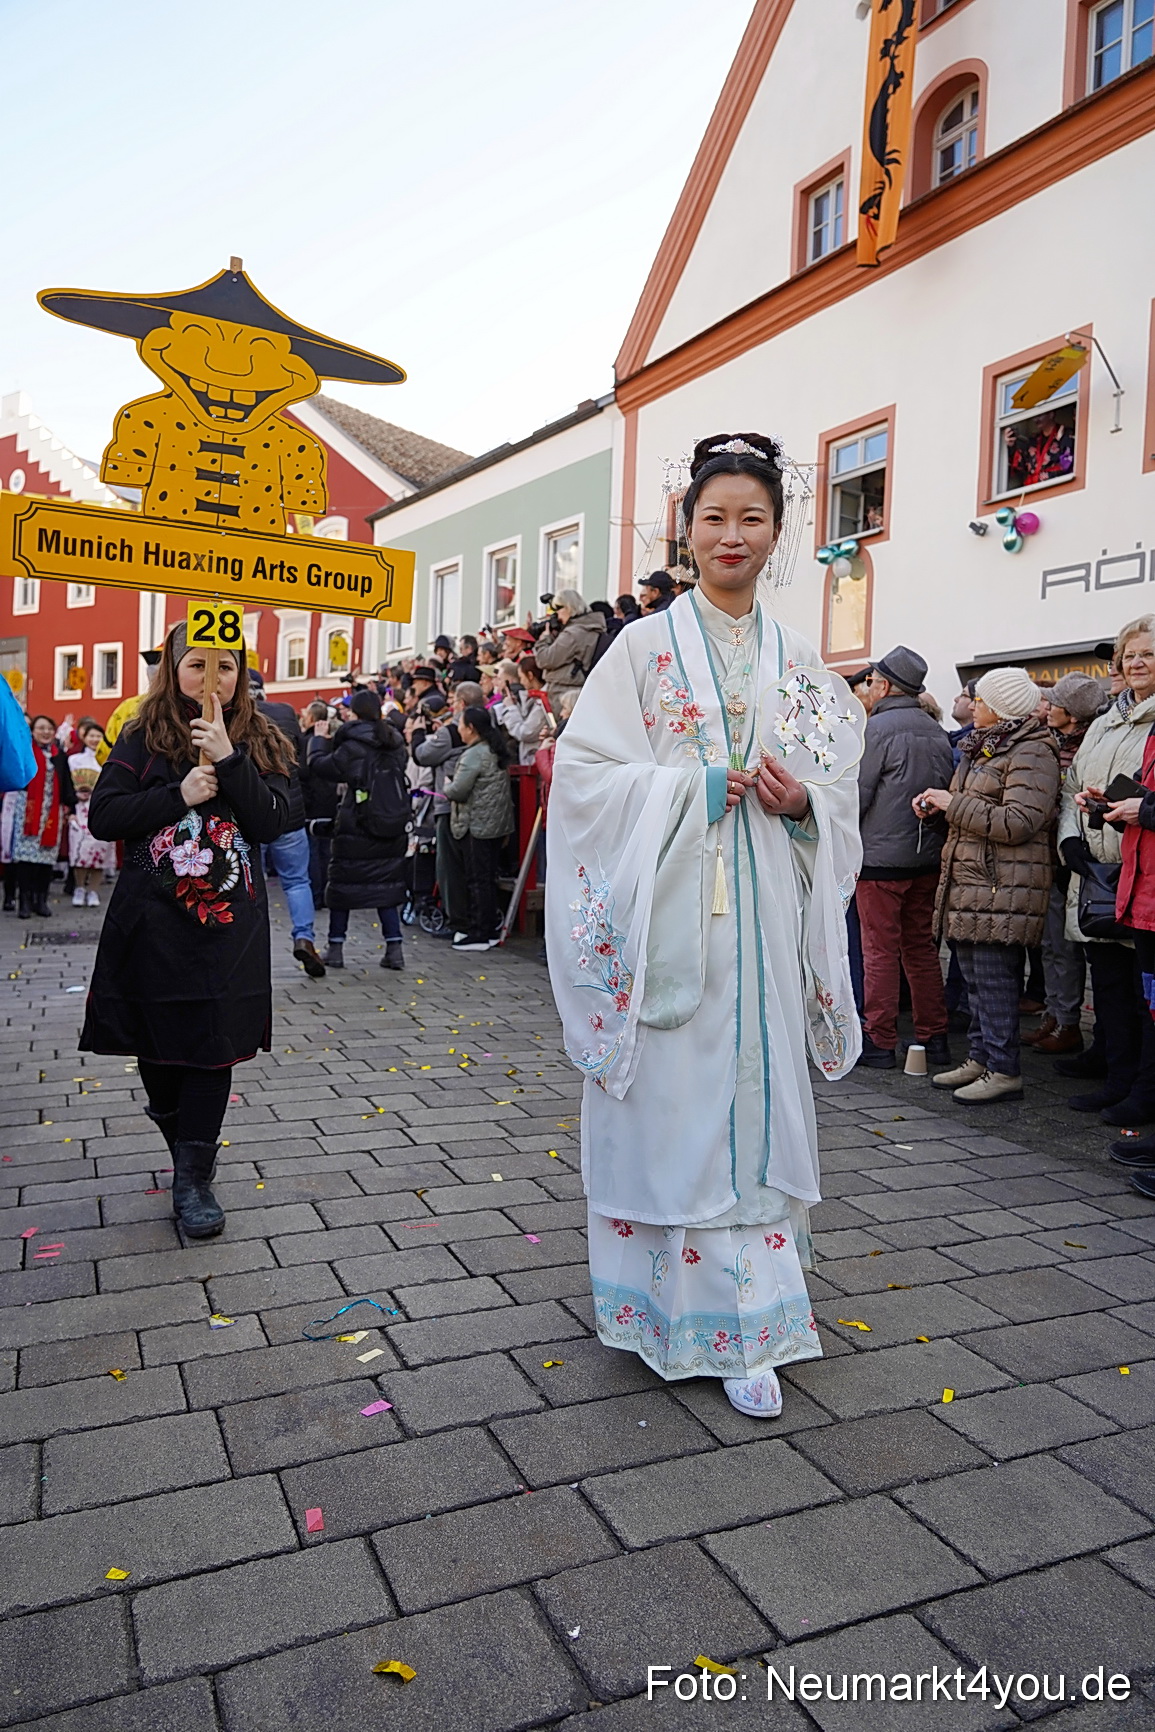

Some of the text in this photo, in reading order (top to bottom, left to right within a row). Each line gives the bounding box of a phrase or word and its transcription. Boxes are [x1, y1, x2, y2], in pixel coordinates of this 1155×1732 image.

[37, 528, 374, 598] Munich Huaxing Arts Group
[1041, 541, 1155, 600] RÖ
[192, 609, 241, 643] 28
